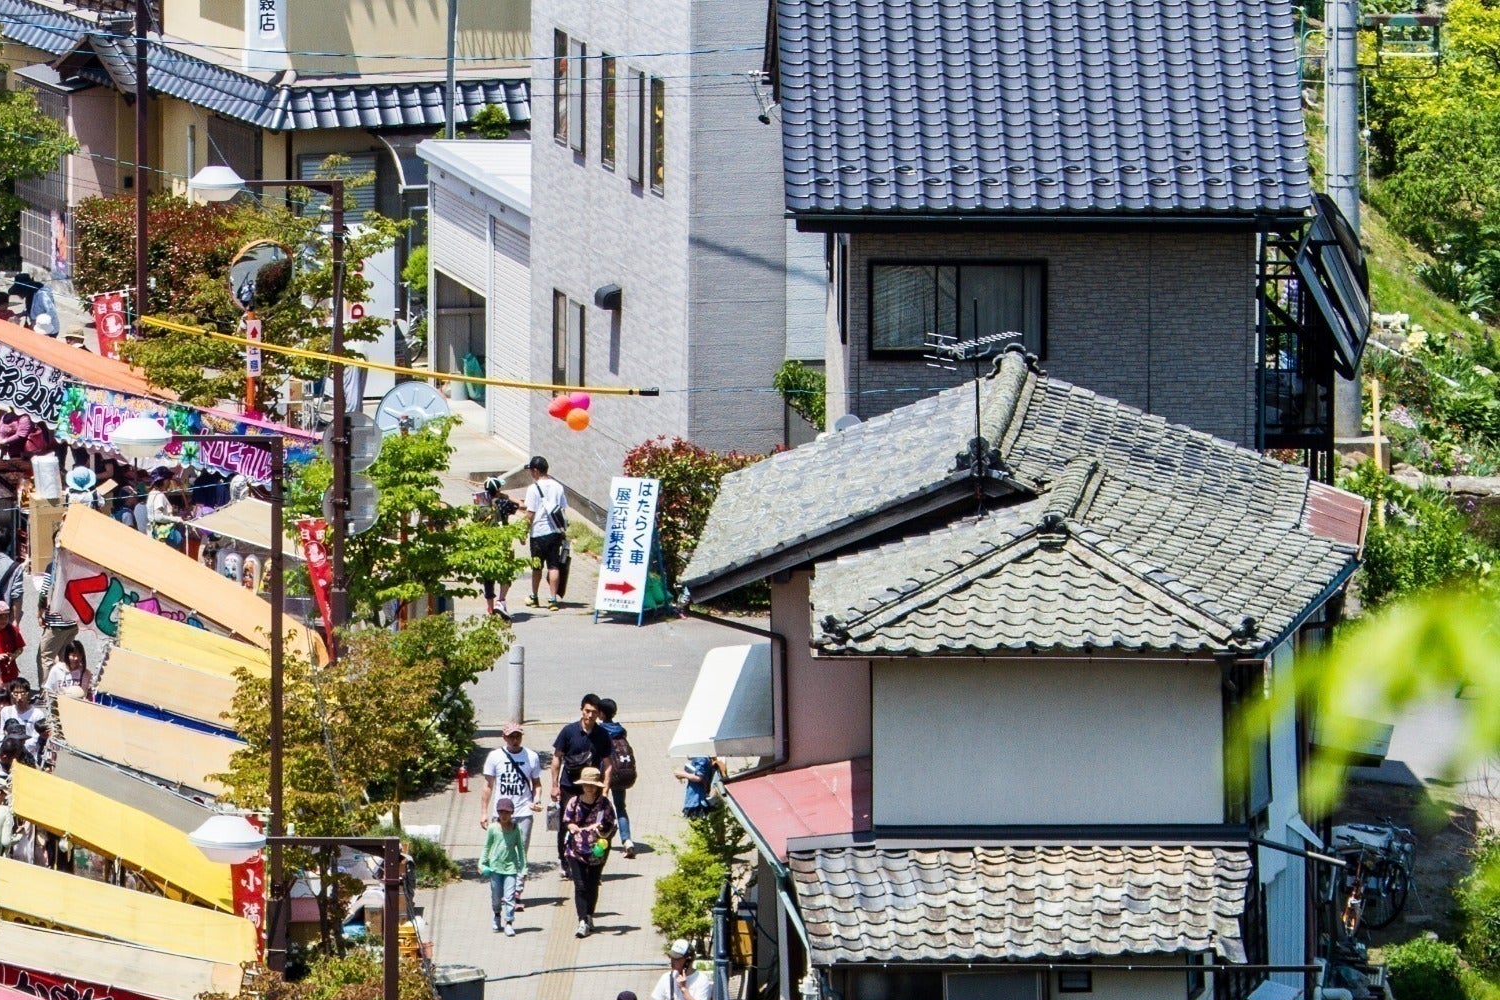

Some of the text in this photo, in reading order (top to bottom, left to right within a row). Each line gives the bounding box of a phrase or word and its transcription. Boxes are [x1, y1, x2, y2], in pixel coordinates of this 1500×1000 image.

[606, 487, 632, 573] 展示試乗会場
[629, 481, 653, 565] はたらく車
